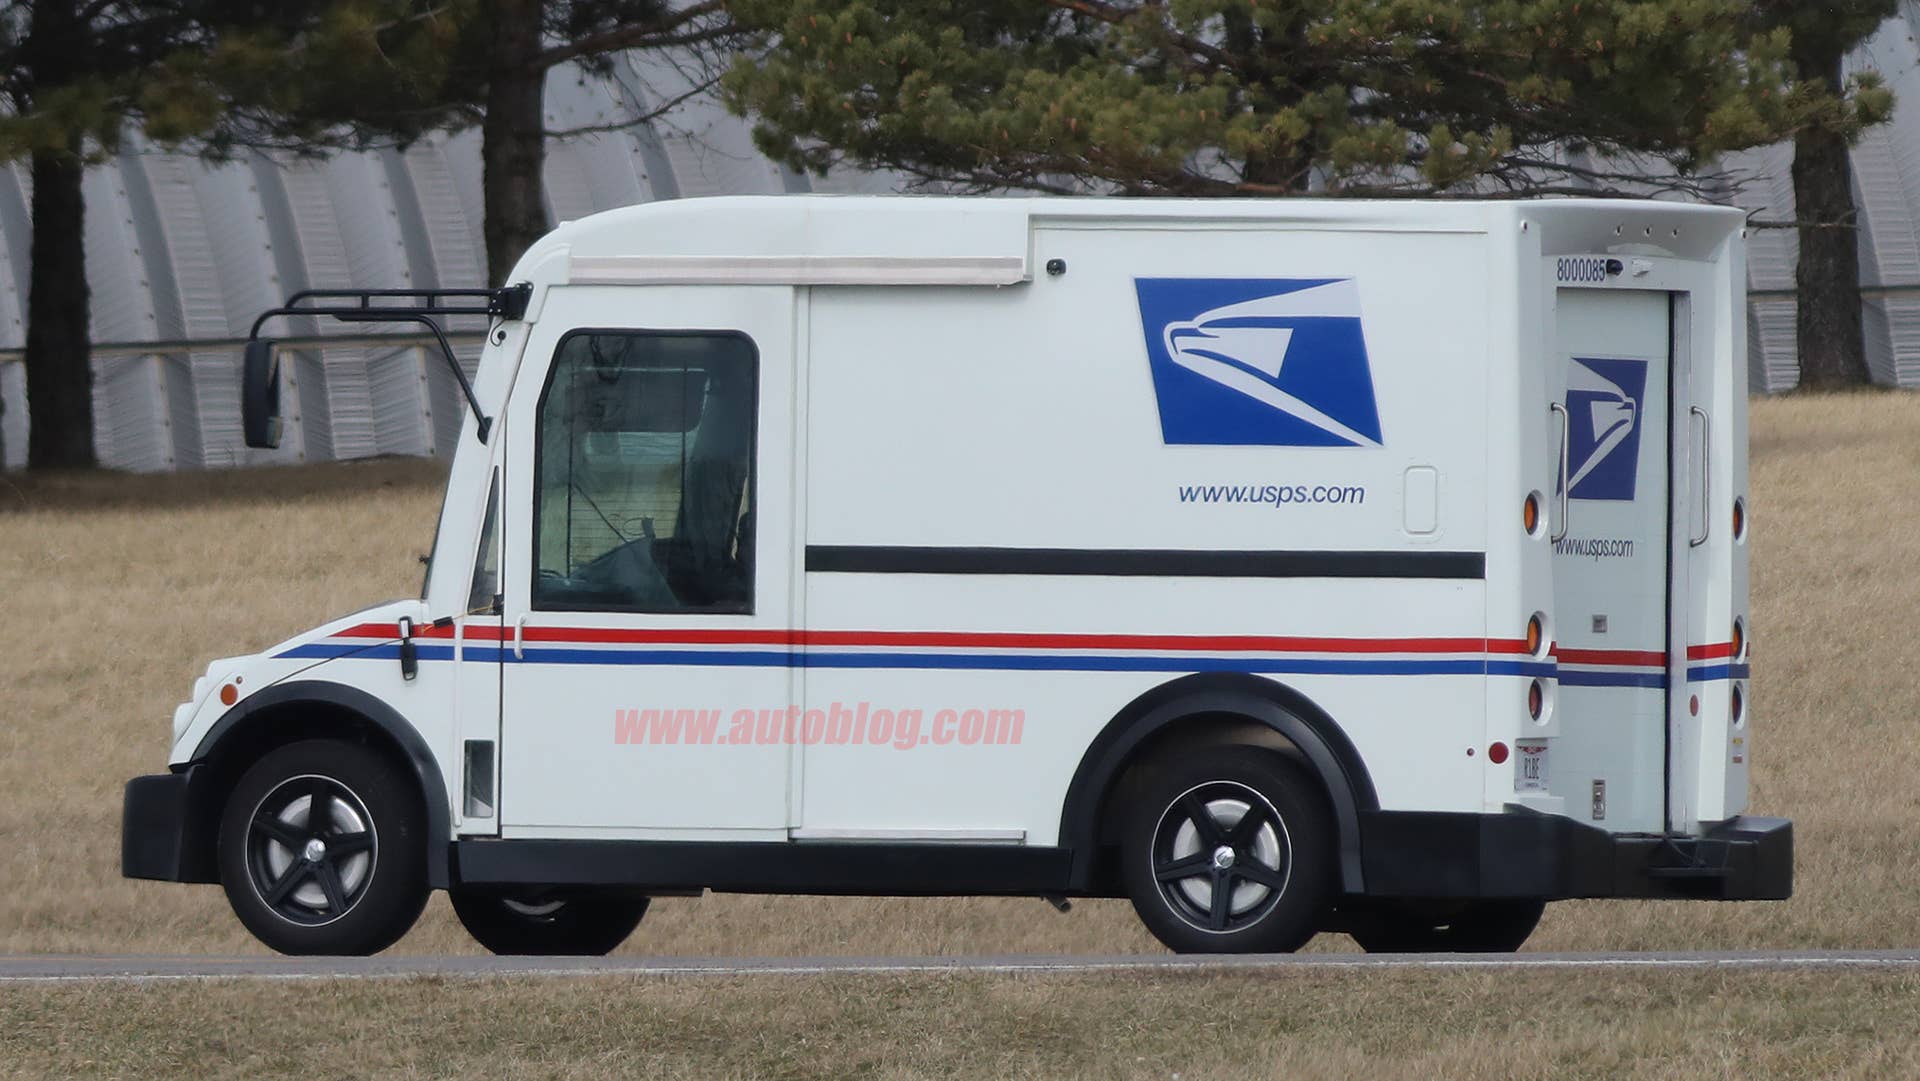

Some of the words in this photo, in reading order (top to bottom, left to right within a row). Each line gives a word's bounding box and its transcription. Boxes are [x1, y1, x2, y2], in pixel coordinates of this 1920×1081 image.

[1557, 258, 1605, 281] 8000085
[1179, 485, 1365, 508] www.usps.com
[1556, 539, 1634, 561] www.usps.com
